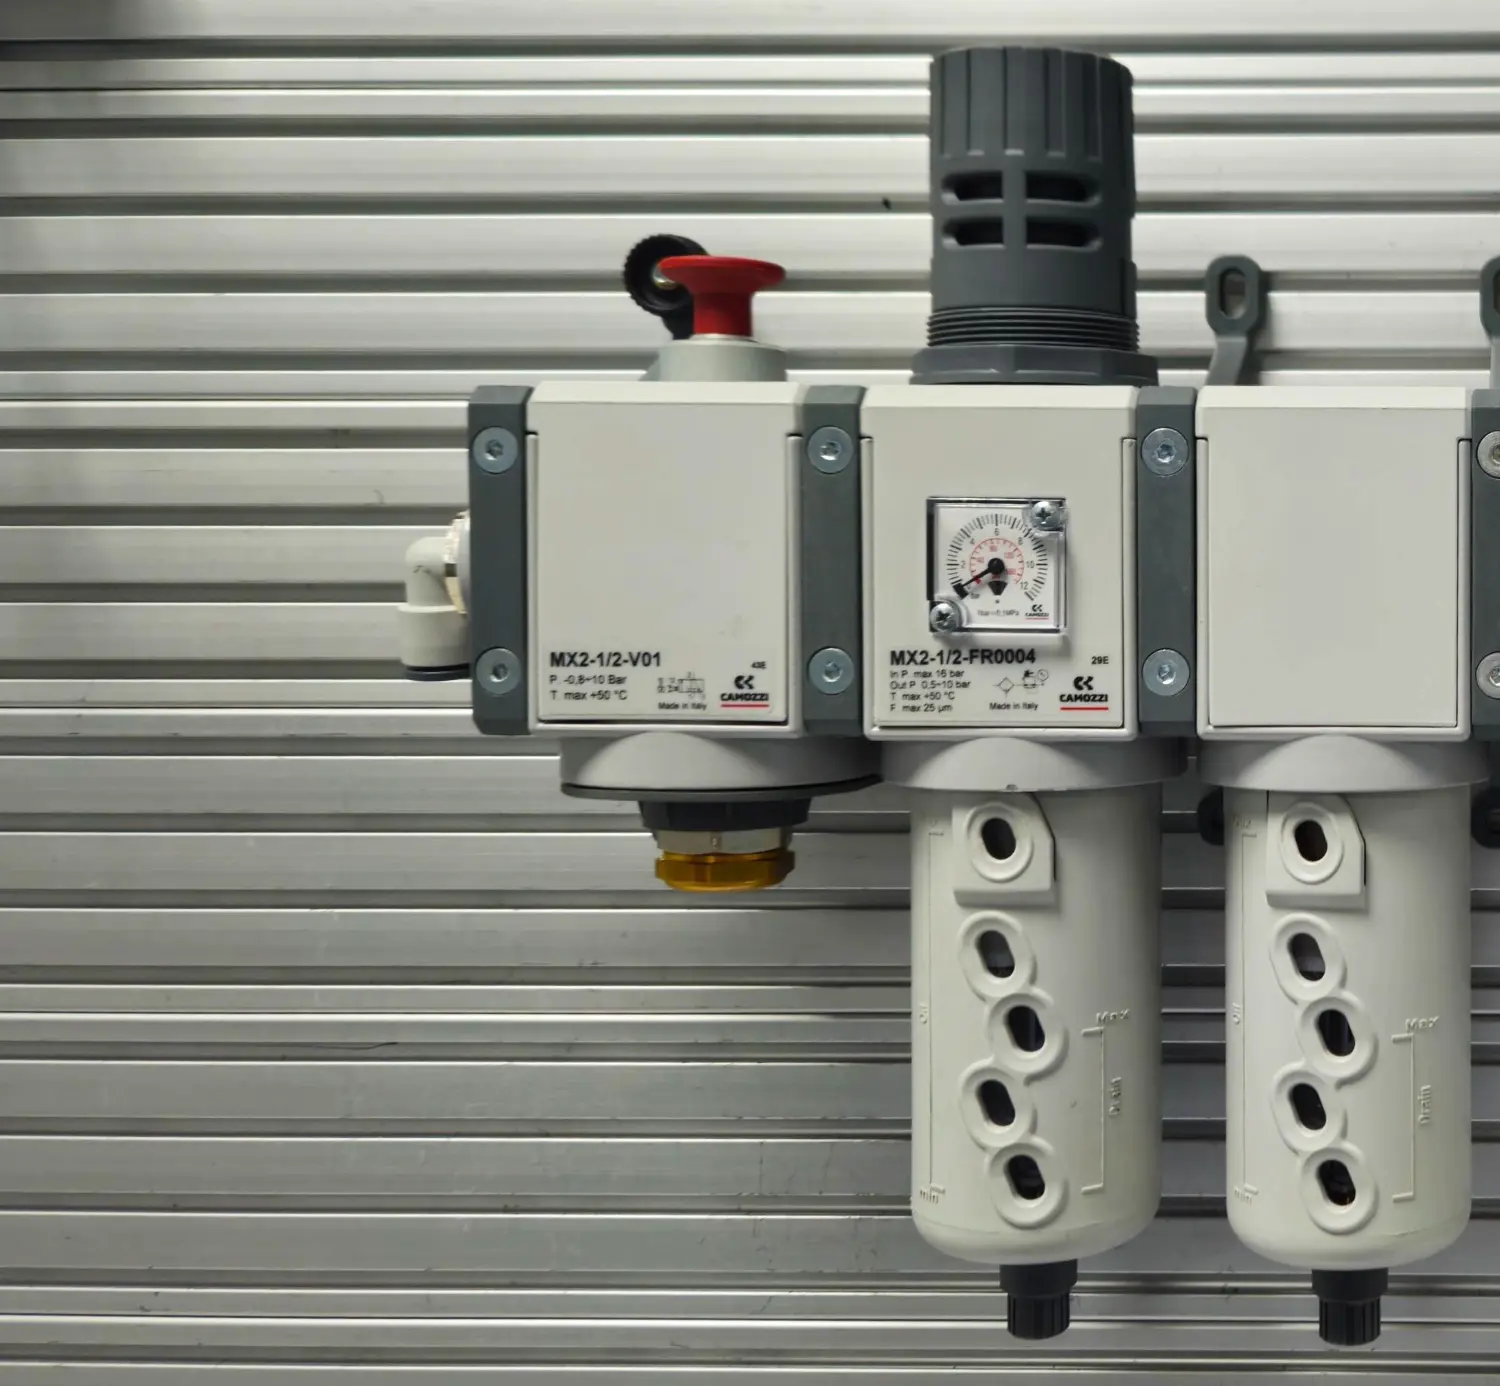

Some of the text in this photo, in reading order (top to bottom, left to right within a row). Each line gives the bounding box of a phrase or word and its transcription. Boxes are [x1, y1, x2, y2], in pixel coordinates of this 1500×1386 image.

[549, 651, 661, 668] MX2-1/2-V01
[890, 648, 1036, 667] MX2-1/2-FR0004
[1091, 656, 1109, 665] 29E
[890, 670, 899, 678] In
[949, 669, 965, 678] bar
[608, 674, 627, 685] Bar
[890, 680, 908, 689] Out
[909, 680, 916, 688] P
[955, 680, 971, 689] bar
[564, 692, 588, 701] max
[720, 693, 769, 702] CAMOZZI
[902, 693, 921, 701] max
[943, 691, 955, 700] °C
[1059, 693, 1109, 703] CAMOZZI
[658, 701, 679, 710] Made
[690, 702, 708, 712] Italy
[923, 703, 935, 712] 25
[989, 702, 1039, 711] Made in Italy
[1405, 1015, 1440, 1031] Max
[1417, 1084, 1432, 1125] Drain
